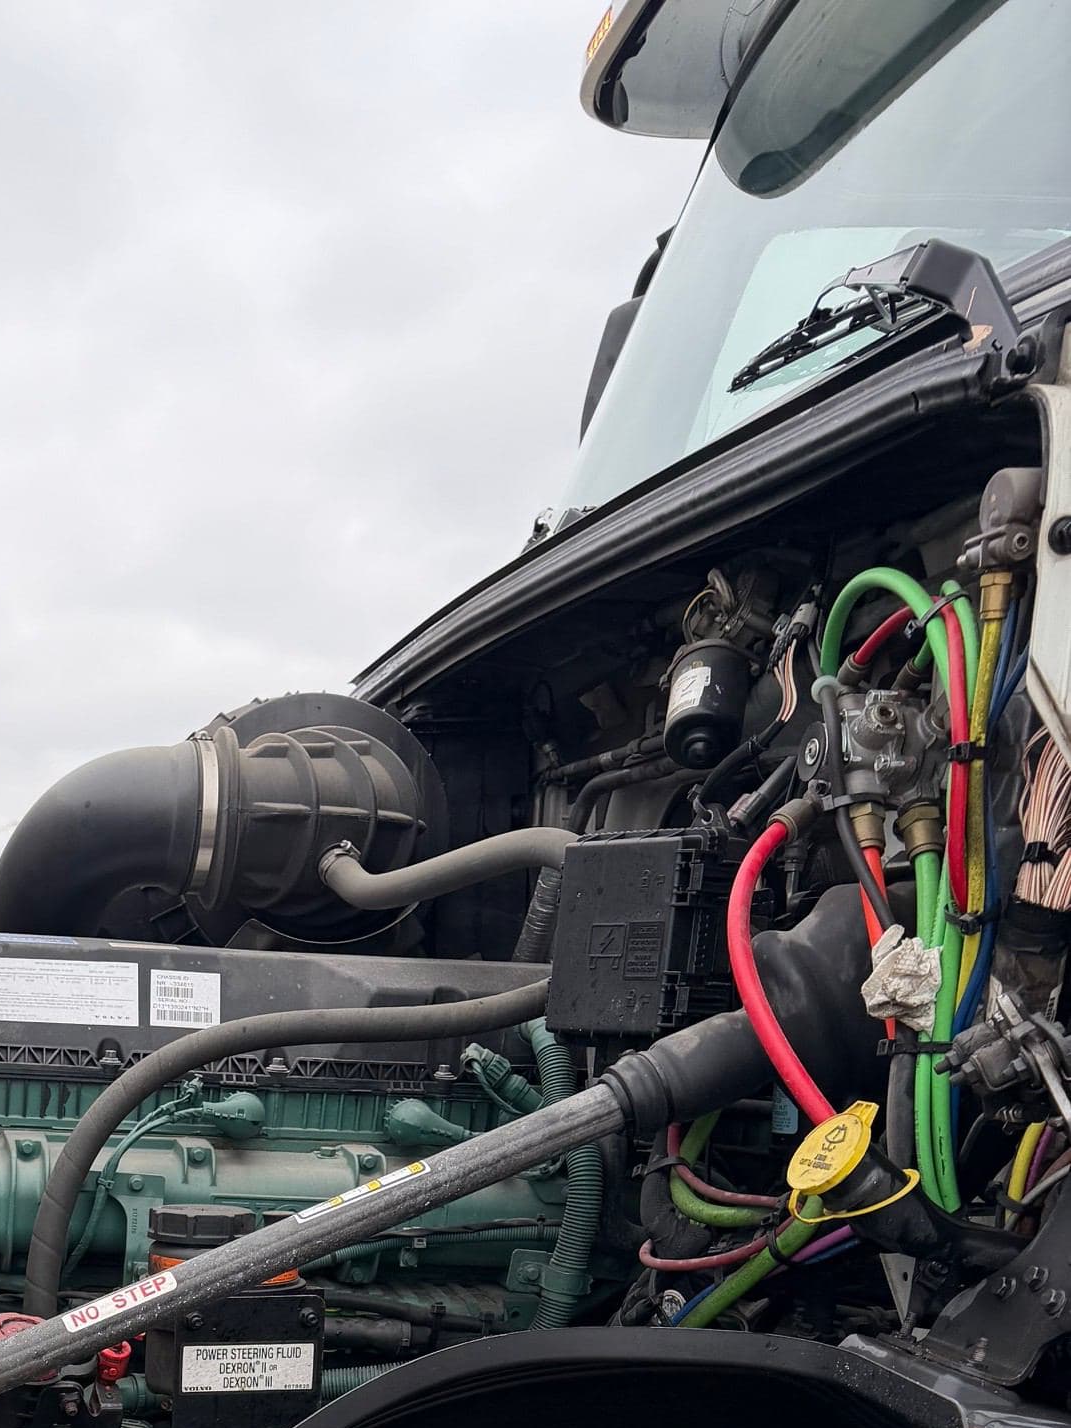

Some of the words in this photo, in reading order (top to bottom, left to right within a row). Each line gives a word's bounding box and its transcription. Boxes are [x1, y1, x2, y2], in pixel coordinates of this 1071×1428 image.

[70, 1306, 99, 1327] NO
[112, 1276, 166, 1308] STEP
[196, 1348, 228, 1360] POWER
[230, 1347, 274, 1360] STEERING
[276, 1346, 302, 1359] FLUID
[261, 1362, 267, 1374] II
[265, 1376, 273, 1387] III
